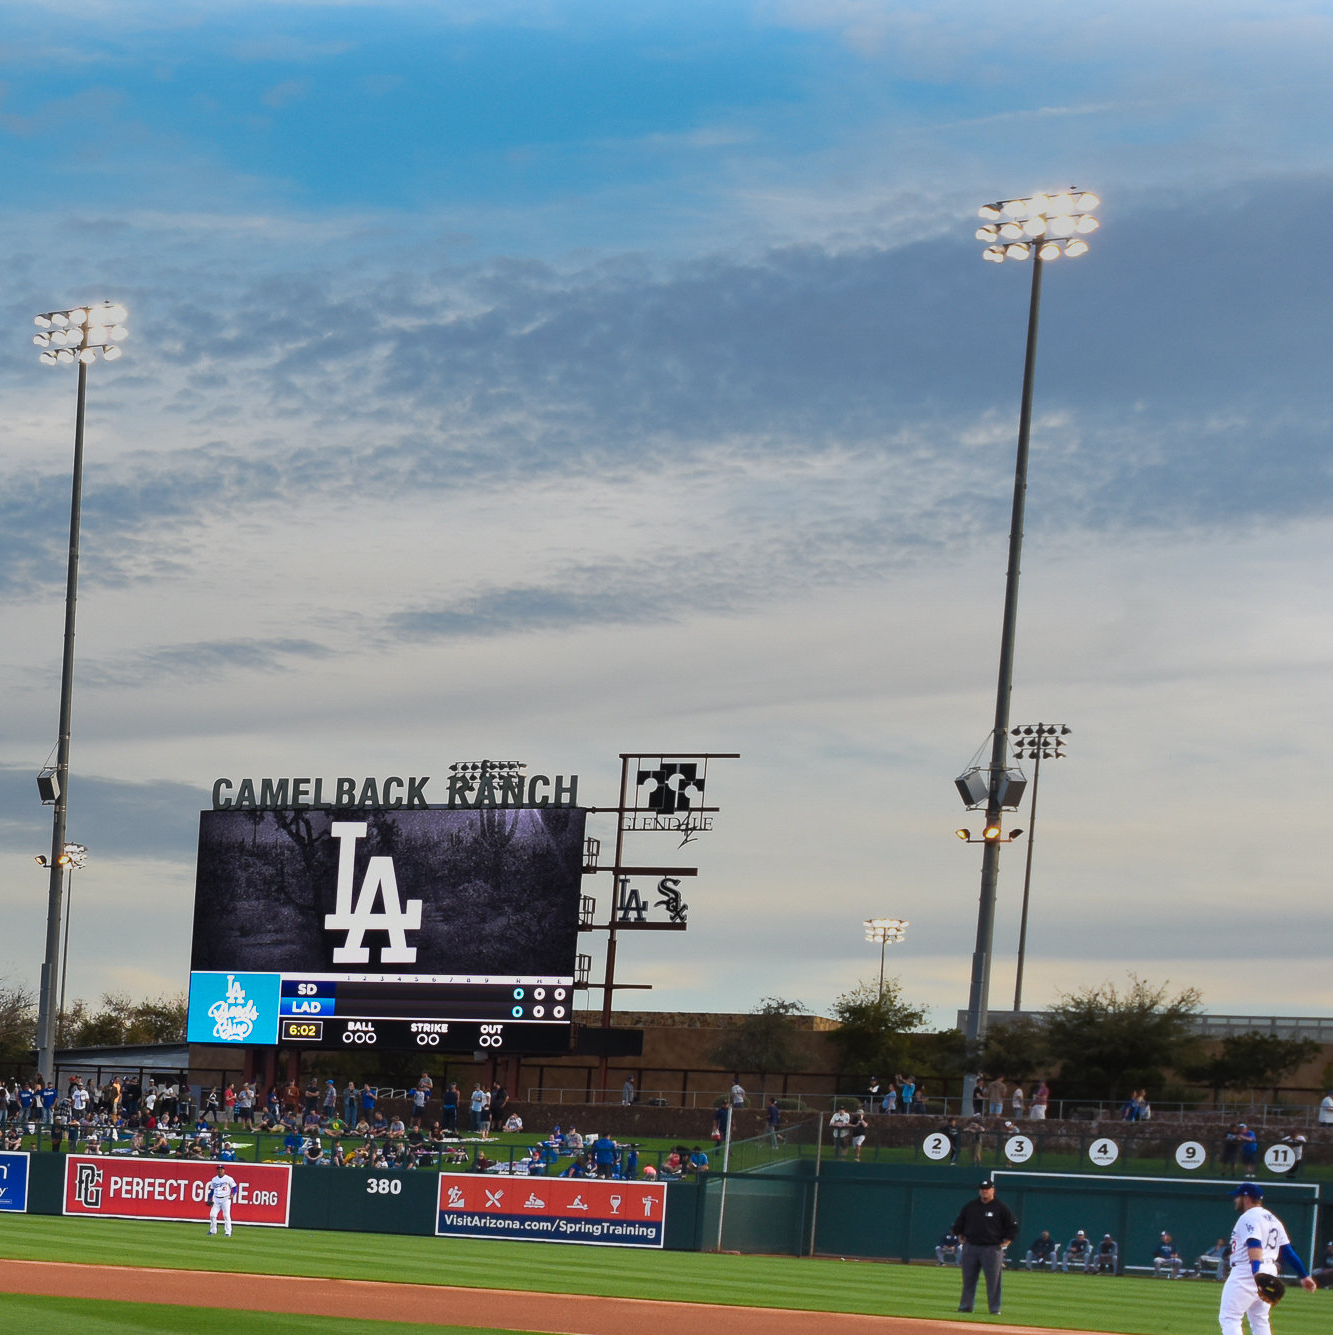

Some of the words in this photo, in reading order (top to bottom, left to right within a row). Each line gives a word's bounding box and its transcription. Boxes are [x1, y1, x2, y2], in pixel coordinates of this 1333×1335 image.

[211, 775, 431, 811] CAMELBACK
[446, 774, 579, 809] RANCH
[622, 815, 714, 832] GLENDALE
[324, 821, 423, 964] LA
[616, 878, 649, 922] LA
[225, 975, 246, 1004] LA
[297, 983, 318, 996] SD
[291, 1000, 322, 1014] LAD
[288, 1025, 316, 1036] 6:02
[347, 1021, 375, 1031] BALL
[410, 1023, 449, 1033] STRIKE
[480, 1024, 504, 1034] OUT
[932, 1138, 942, 1150] 2
[1014, 1140, 1024, 1152] 3
[1097, 1143, 1109, 1155] 4
[1185, 1146, 1196, 1158] 9
[1272, 1149, 1288, 1162] 11
[109, 1176, 189, 1201] PERFECT
[366, 1178, 402, 1195] 380
[444, 1213, 656, 1239] VisitArizona.com/SpringTraining
